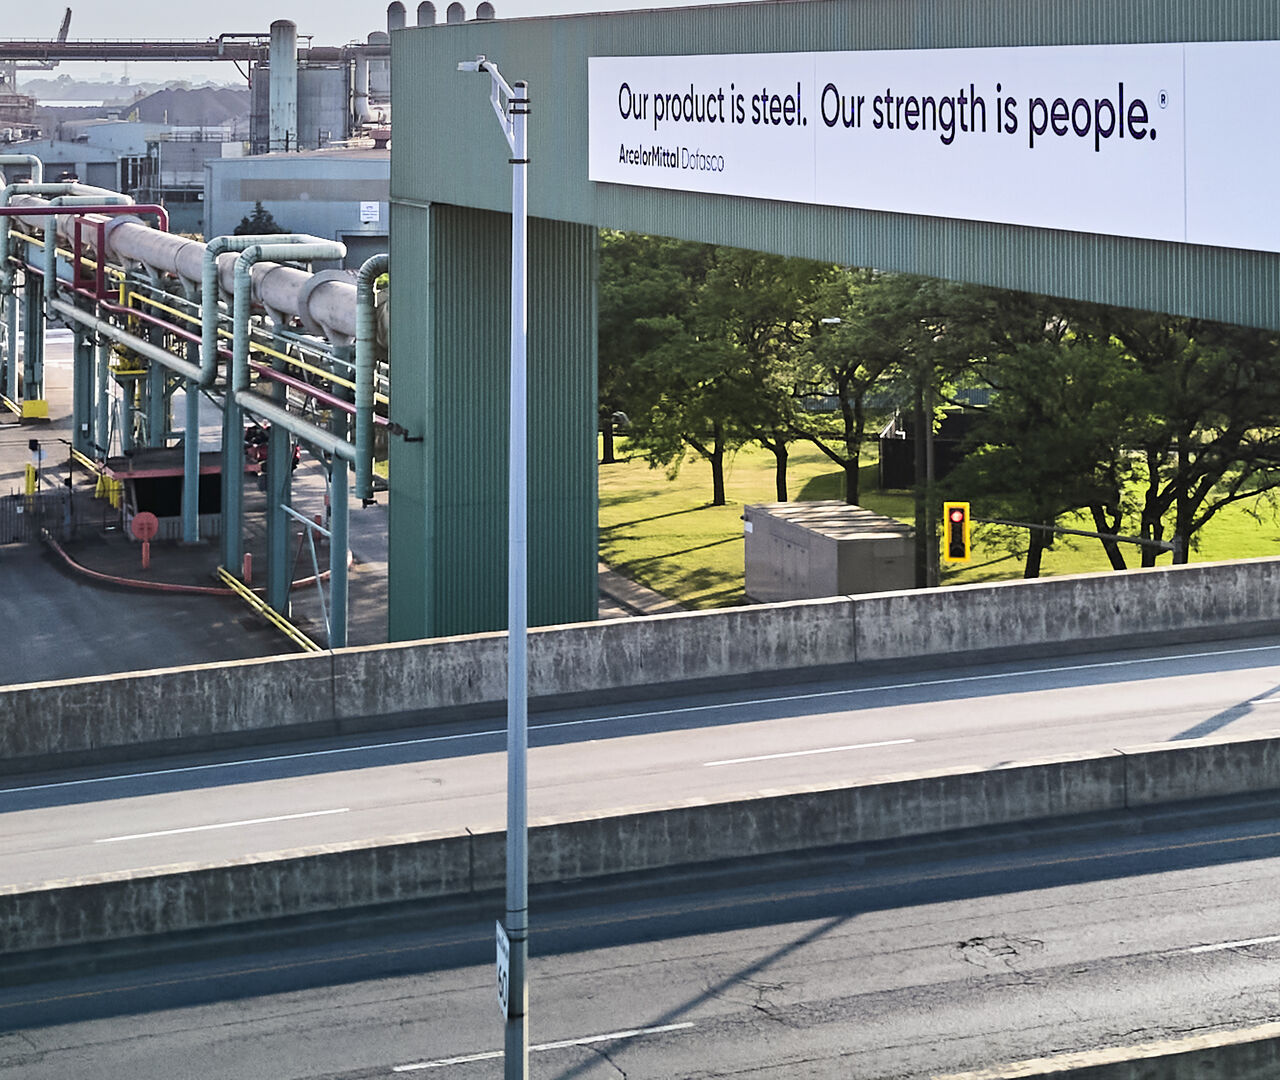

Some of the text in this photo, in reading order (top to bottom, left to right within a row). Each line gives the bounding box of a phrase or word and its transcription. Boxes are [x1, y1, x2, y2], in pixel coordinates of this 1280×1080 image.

[618, 82, 649, 121] Our
[653, 83, 725, 132] product
[730, 82, 746, 125] is
[751, 81, 808, 127] steel.
[820, 82, 866, 129] Our
[872, 83, 987, 146] strength
[996, 82, 1019, 135] is
[1028, 81, 1157, 153] people.
[619, 143, 725, 173] ArcelorMittal Dofasco
